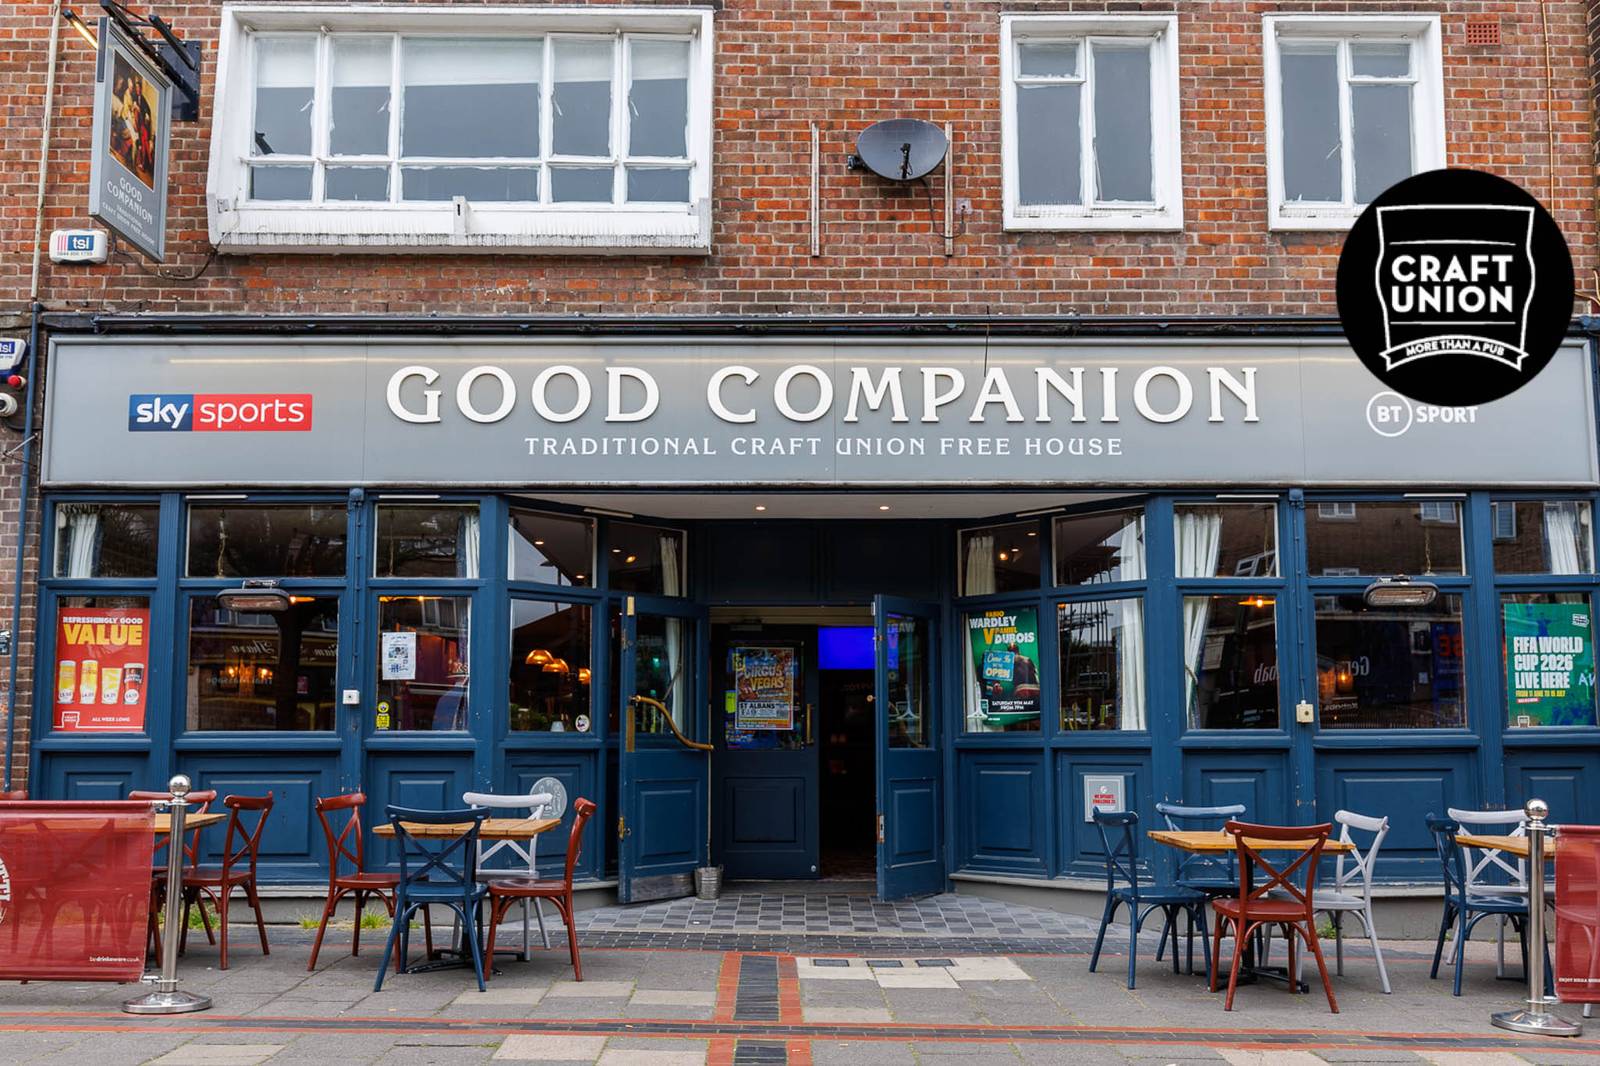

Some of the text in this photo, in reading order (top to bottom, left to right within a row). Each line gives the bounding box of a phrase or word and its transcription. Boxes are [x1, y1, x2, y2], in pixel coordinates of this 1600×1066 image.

[120, 177, 142, 202] GOOD
[106, 181, 153, 224] COMPANION
[386, 365, 1260, 424] GOOD COMPANION
[136, 397, 304, 429] sky sports
[1376, 405, 1478, 423] BT SPORT
[524, 438, 1122, 456] TRADITIONAL CRAFT UNION FREE HOUSE
[969, 616, 1017, 628] WARDLEY
[63, 624, 143, 646] VALUE
[983, 628, 1034, 645] V DUBOIS
[1514, 636, 1583, 653] FIFA WORLD
[744, 664, 783, 678] CIRCUS
[1514, 654, 1573, 671] CUP 2026
[750, 677, 785, 690] VEGAS
[1515, 672, 1570, 688] LIVE HERE
